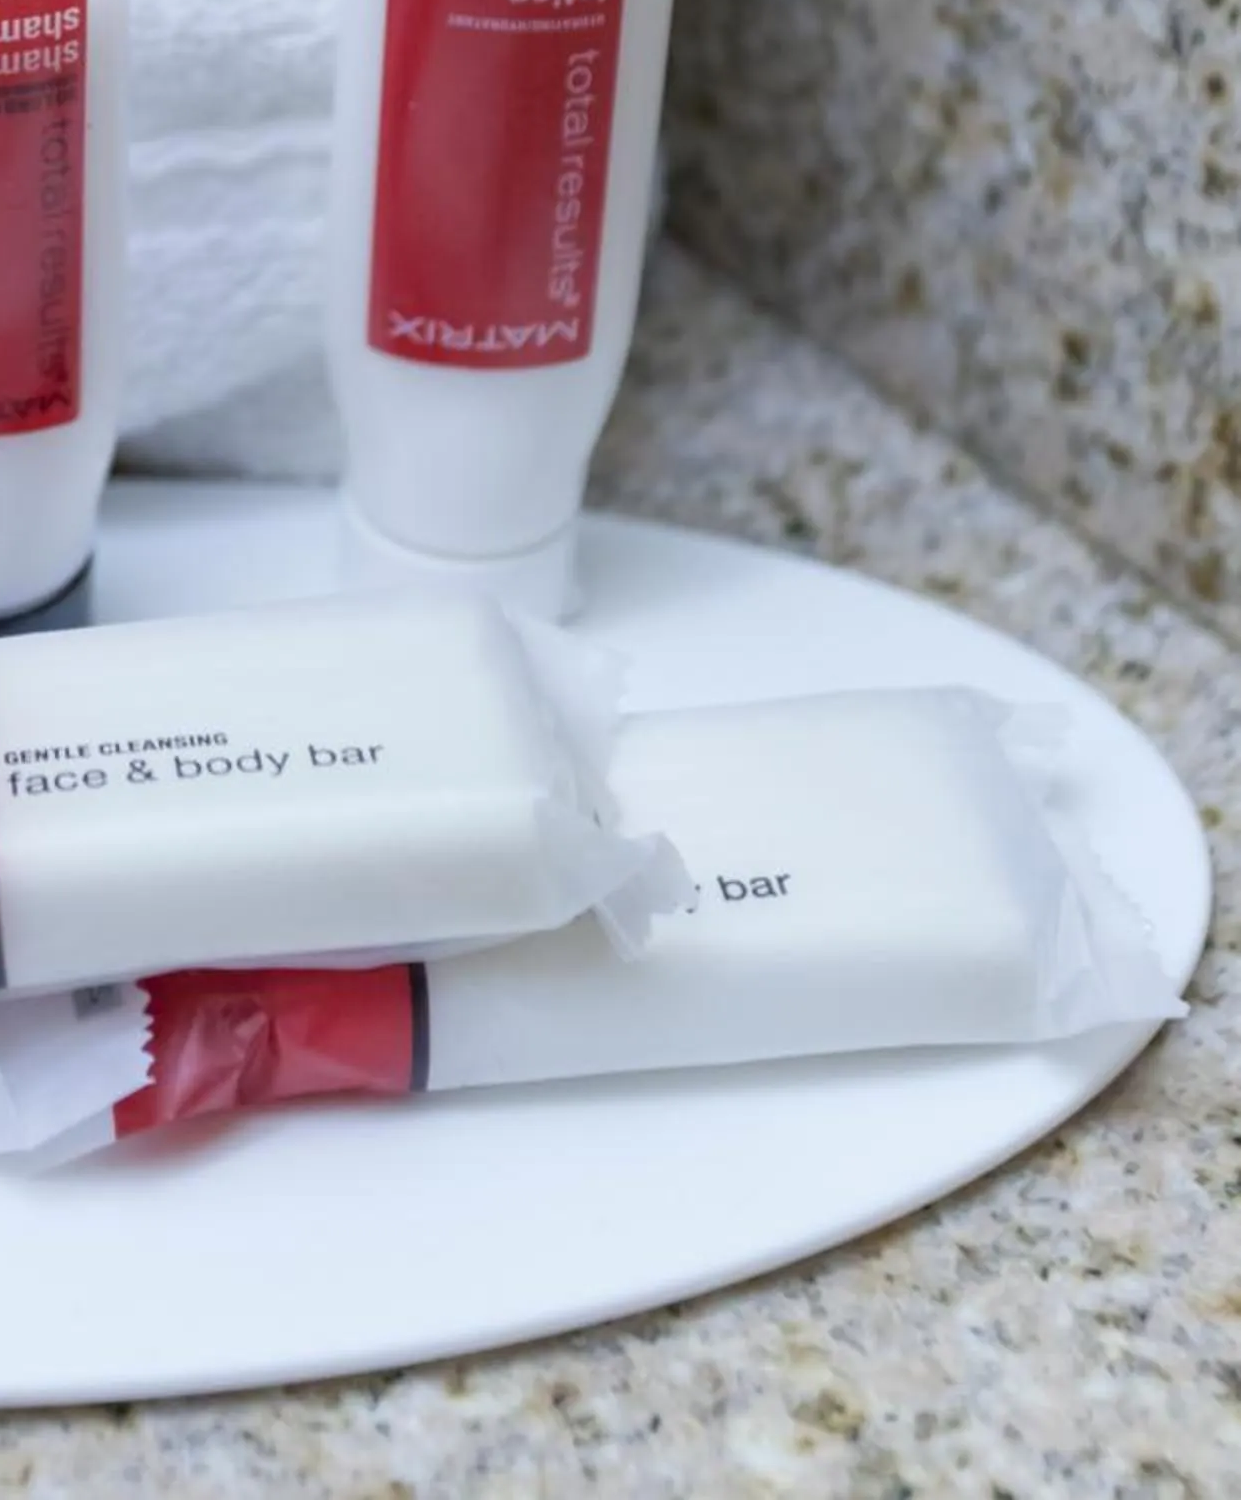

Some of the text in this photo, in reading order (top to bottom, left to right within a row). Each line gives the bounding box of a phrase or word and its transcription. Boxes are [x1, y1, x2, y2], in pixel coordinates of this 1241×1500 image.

[388, 310, 580, 353] MATRIX
[4, 732, 229, 765] GENTLE CLEANSING
[7, 740, 387, 798] face & body bar
[716, 872, 792, 902] bar
